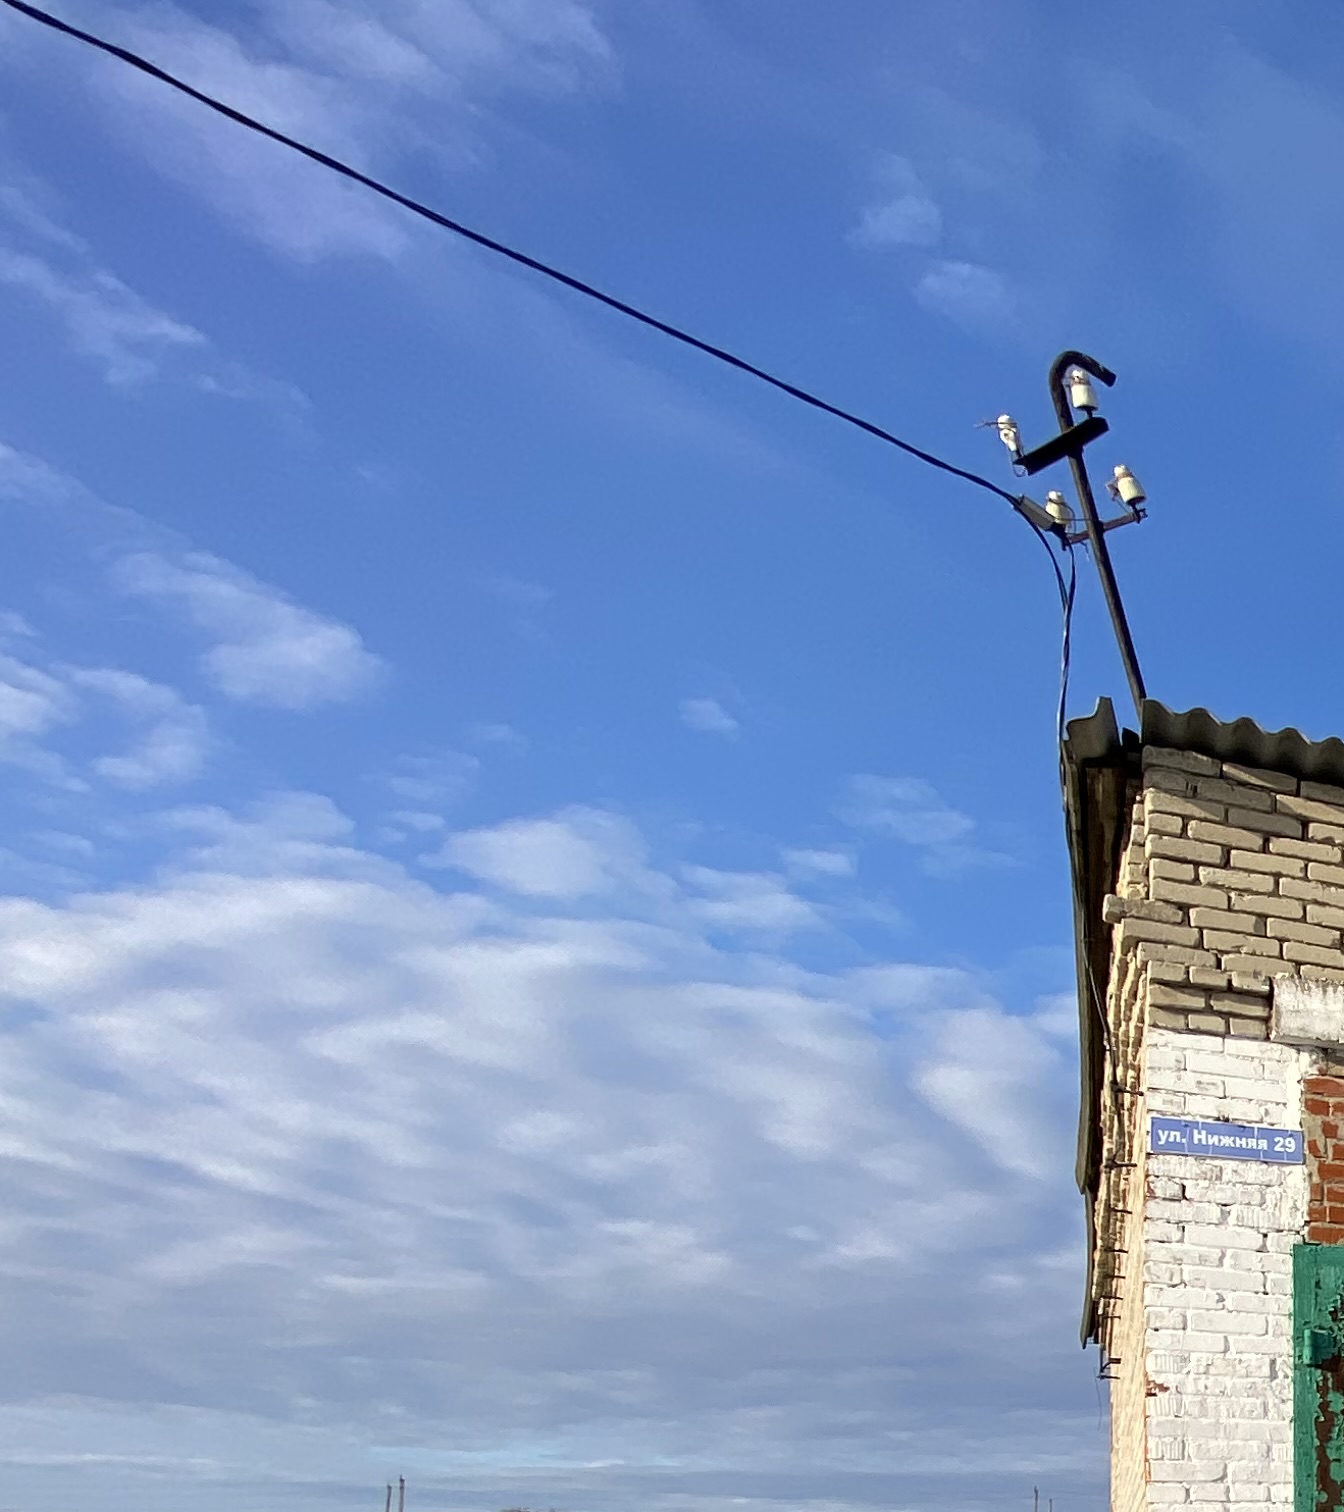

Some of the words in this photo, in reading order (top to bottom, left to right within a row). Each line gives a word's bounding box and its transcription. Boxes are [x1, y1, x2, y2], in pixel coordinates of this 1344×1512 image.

[1157, 1129, 1186, 1144] ул.
[1192, 1129, 1268, 1151] Нижняя
[1273, 1137, 1296, 1153] 29
